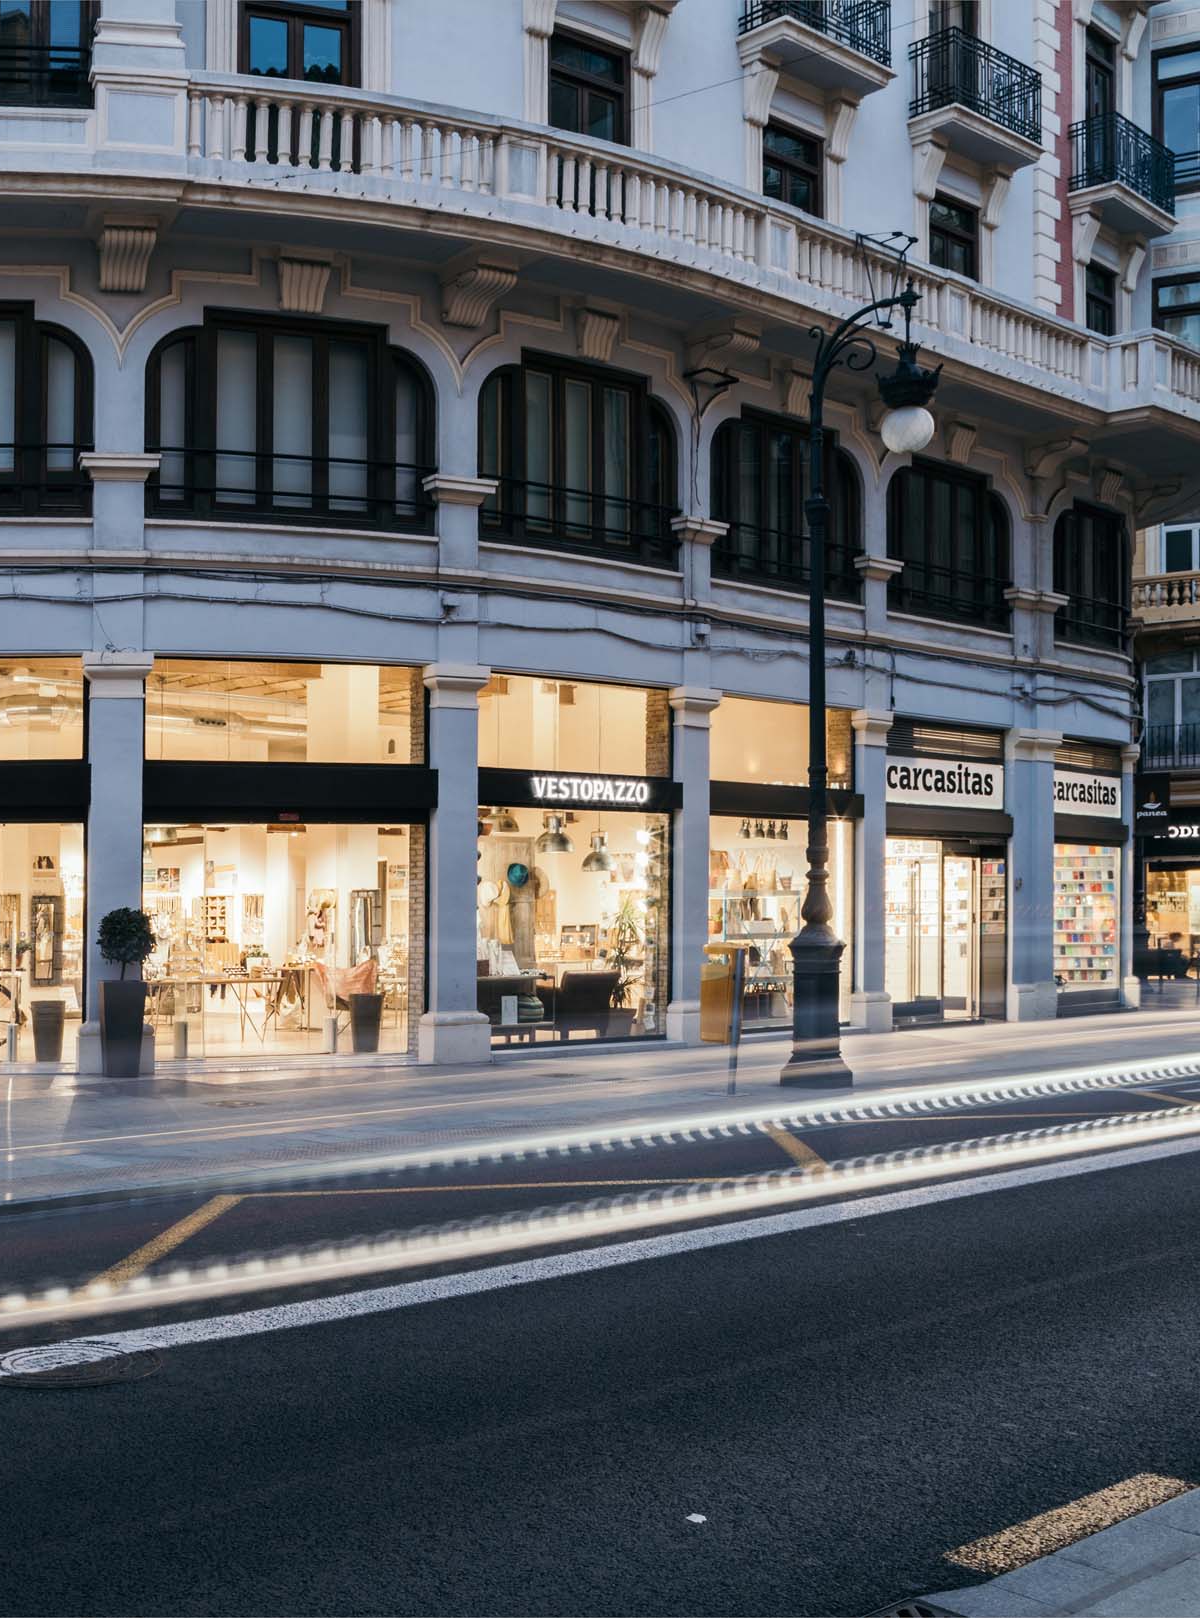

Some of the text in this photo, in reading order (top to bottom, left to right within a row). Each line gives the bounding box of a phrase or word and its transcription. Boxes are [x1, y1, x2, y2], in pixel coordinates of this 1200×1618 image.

[530, 776, 650, 803] VESTOPAZZO
[887, 764, 994, 796] carcasitas
[1136, 810, 1168, 820] panea
